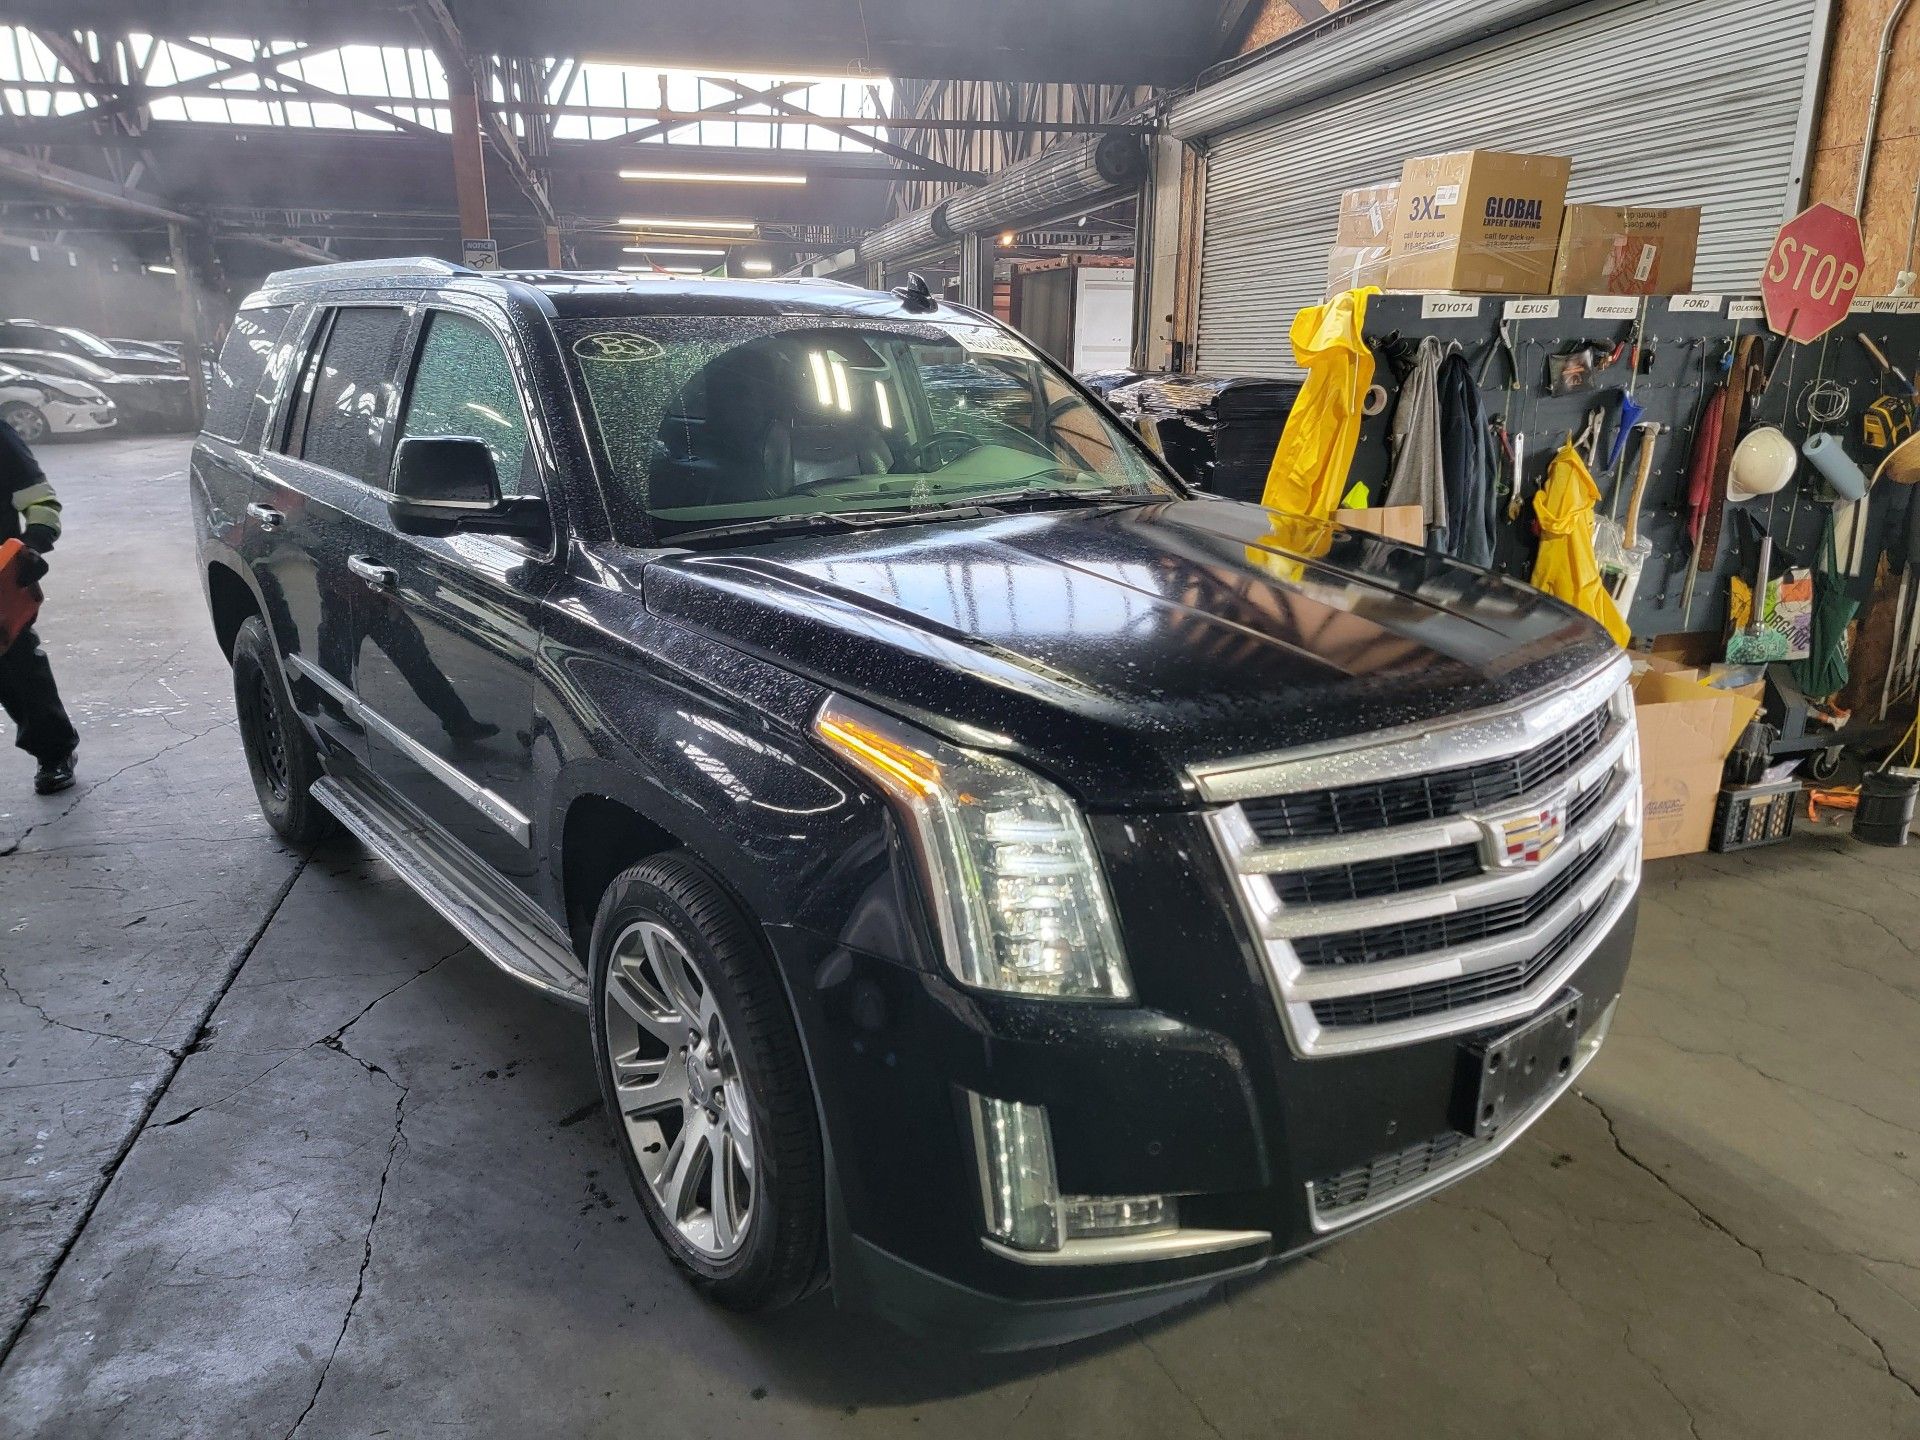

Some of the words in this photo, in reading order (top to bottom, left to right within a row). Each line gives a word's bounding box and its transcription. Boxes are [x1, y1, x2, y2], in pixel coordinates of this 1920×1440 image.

[1409, 195, 1446, 221] 3XL
[1485, 196, 1543, 221] GLOBAL
[1483, 218, 1508, 228] EXPERT
[1509, 220, 1541, 230] SHIPPING
[1645, 221, 1661, 230] How
[1403, 231, 1414, 239] call
[1414, 230, 1422, 239] for
[1422, 230, 1436, 241] pick
[1436, 231, 1445, 239] up
[1484, 232, 1498, 240] call
[1498, 232, 1509, 241] for
[1509, 233, 1524, 241] pick
[466, 242, 493, 250] NOTICE
[1768, 236, 1859, 307] STOP
[1431, 303, 1473, 313] TOYOTA
[1682, 299, 1710, 308] FORD
[1875, 301, 1896, 310] MINI
[1898, 301, 1920, 310] FIAT
[1514, 304, 1549, 314] LEXUS
[1595, 306, 1634, 314] MERCEDES
